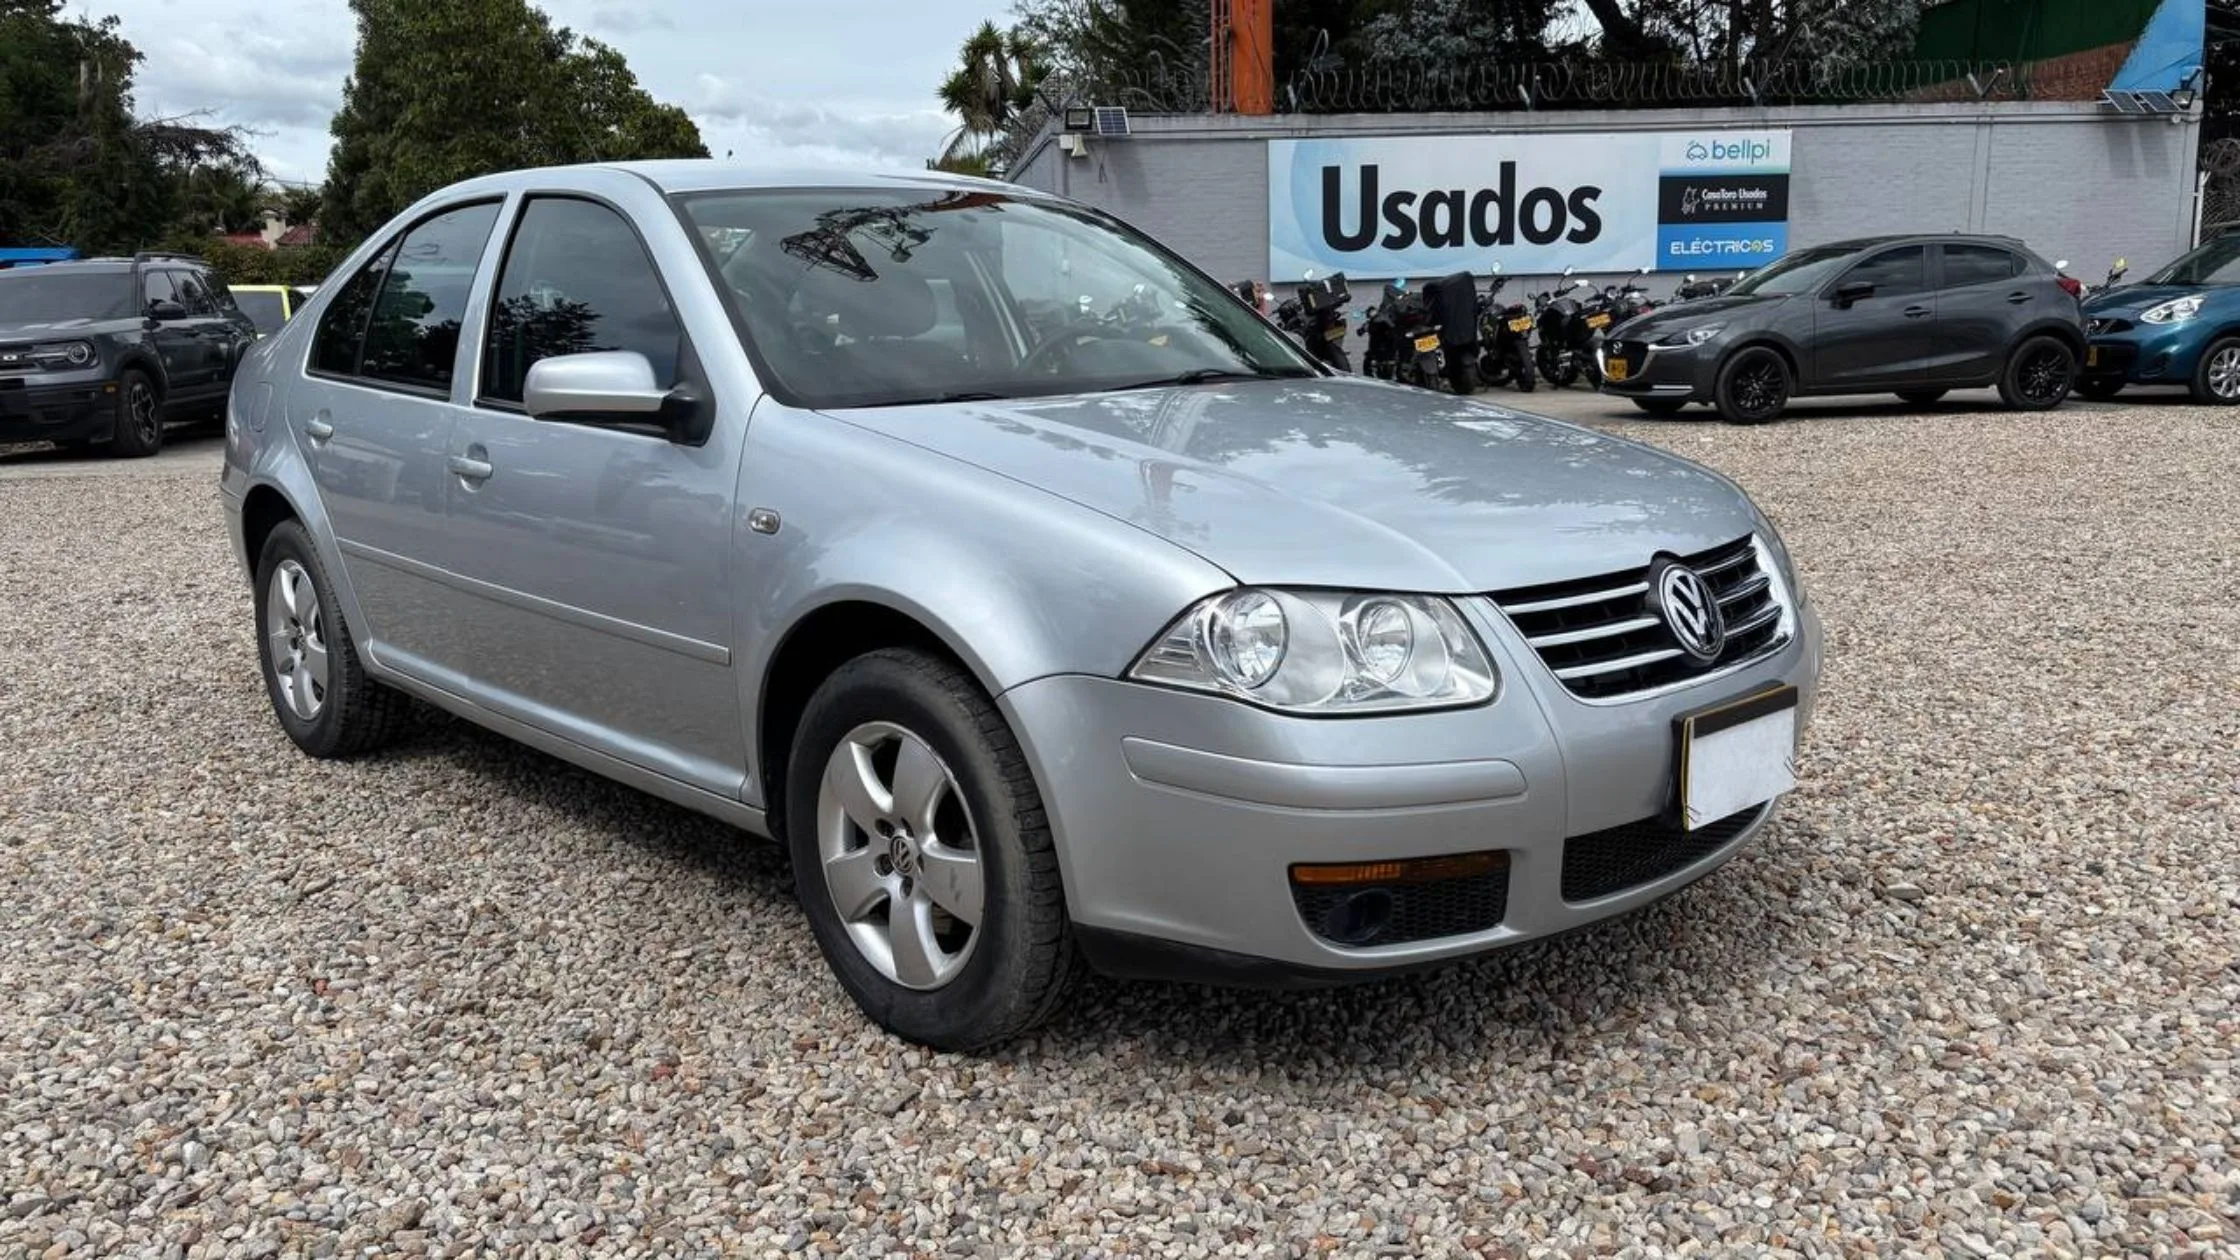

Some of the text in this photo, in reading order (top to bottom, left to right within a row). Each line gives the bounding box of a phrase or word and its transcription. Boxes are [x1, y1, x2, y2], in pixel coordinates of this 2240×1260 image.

[1712, 138, 1771, 164] bellpi
[1739, 187, 1768, 199] Usados
[1321, 160, 1603, 252] Usados
[1704, 202, 1763, 211] PREMIUM
[1670, 237, 1774, 256] ELÉCTRICOS
